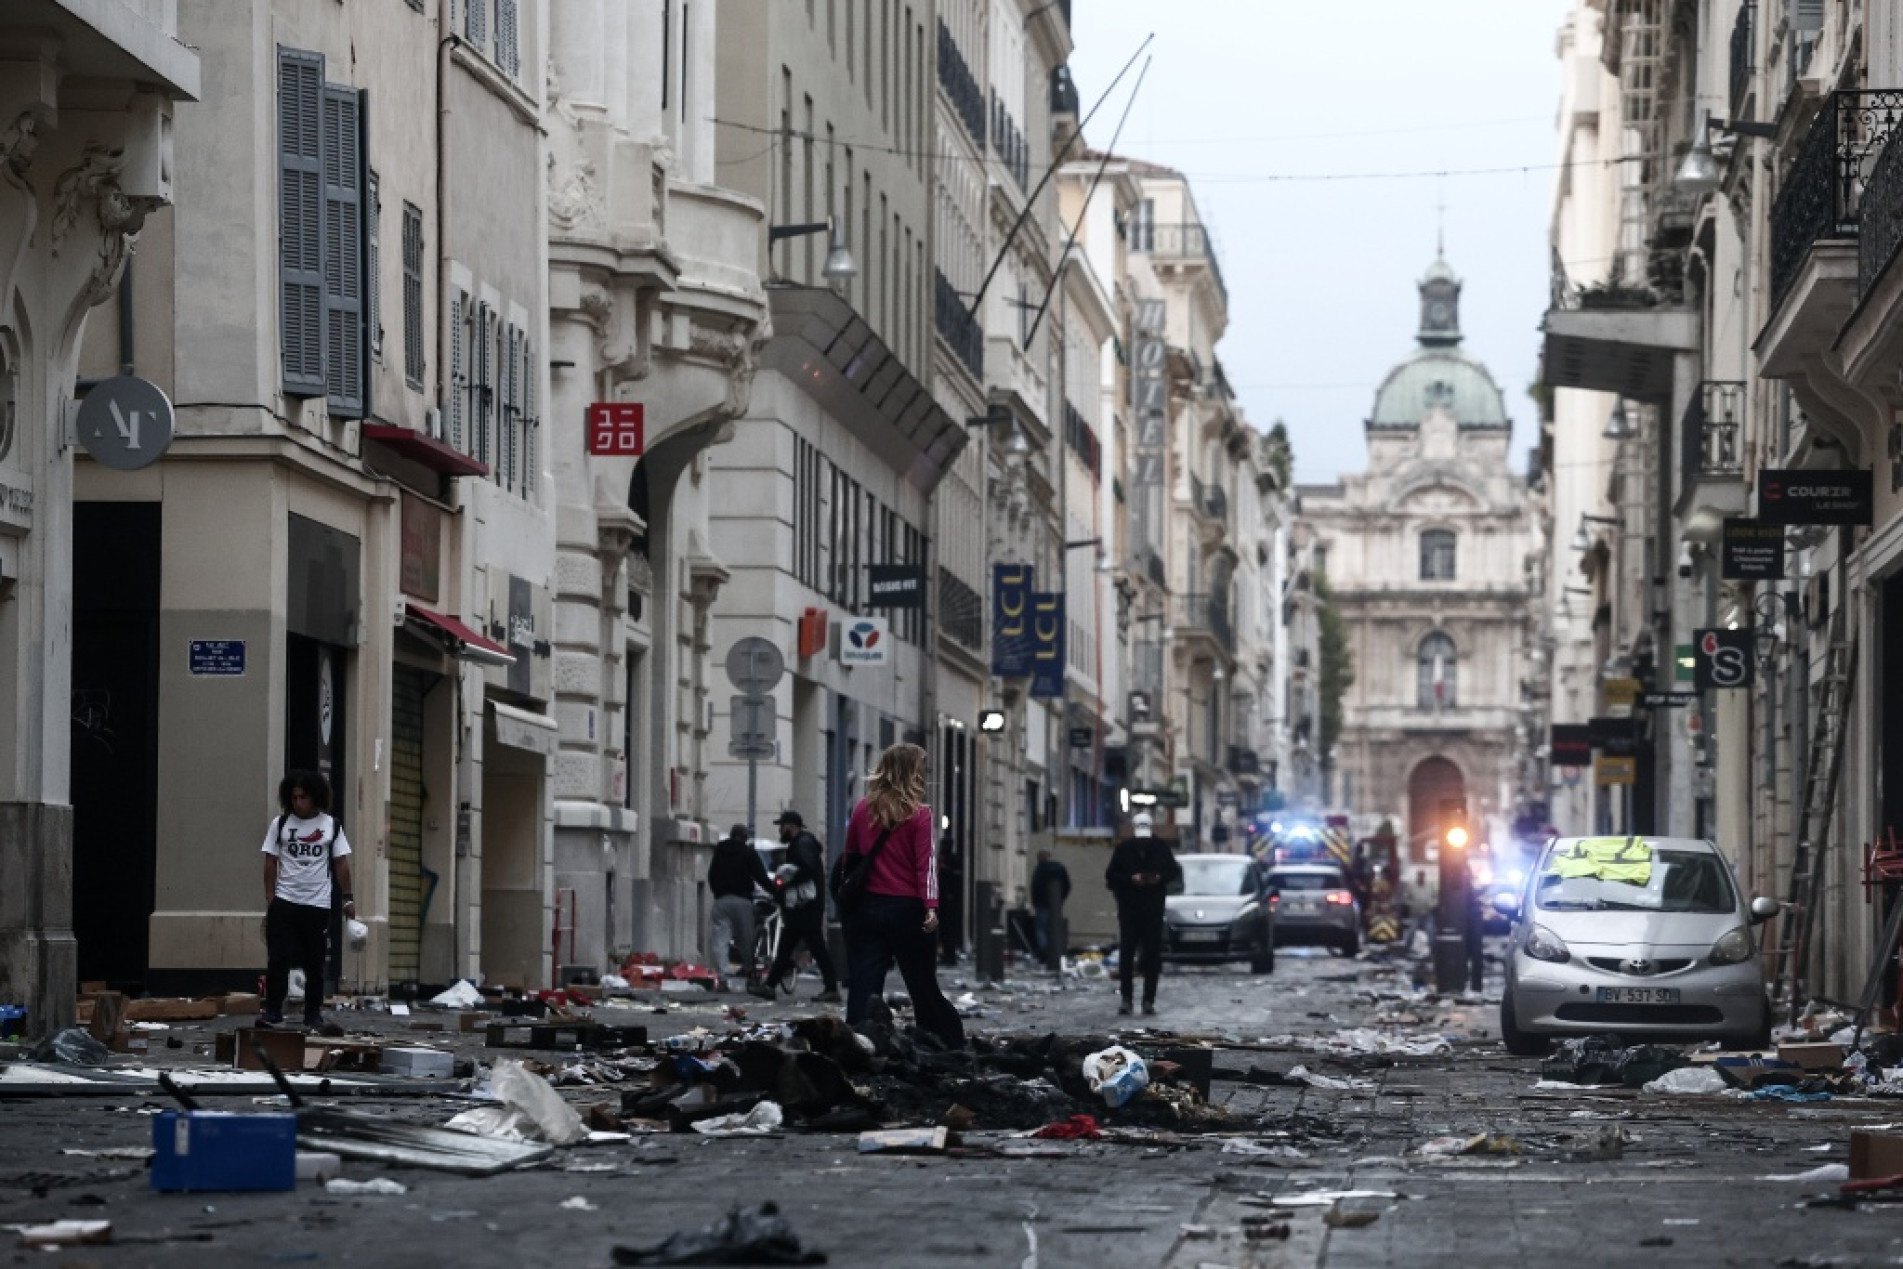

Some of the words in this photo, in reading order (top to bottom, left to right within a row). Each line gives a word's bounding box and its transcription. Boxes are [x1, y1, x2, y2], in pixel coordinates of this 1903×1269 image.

[1141, 301, 1164, 481] HOTEL
[1000, 566, 1024, 637] LCL
[1034, 593, 1058, 660] LCL
[287, 828, 298, 843] I
[287, 843, 323, 858] QRO
